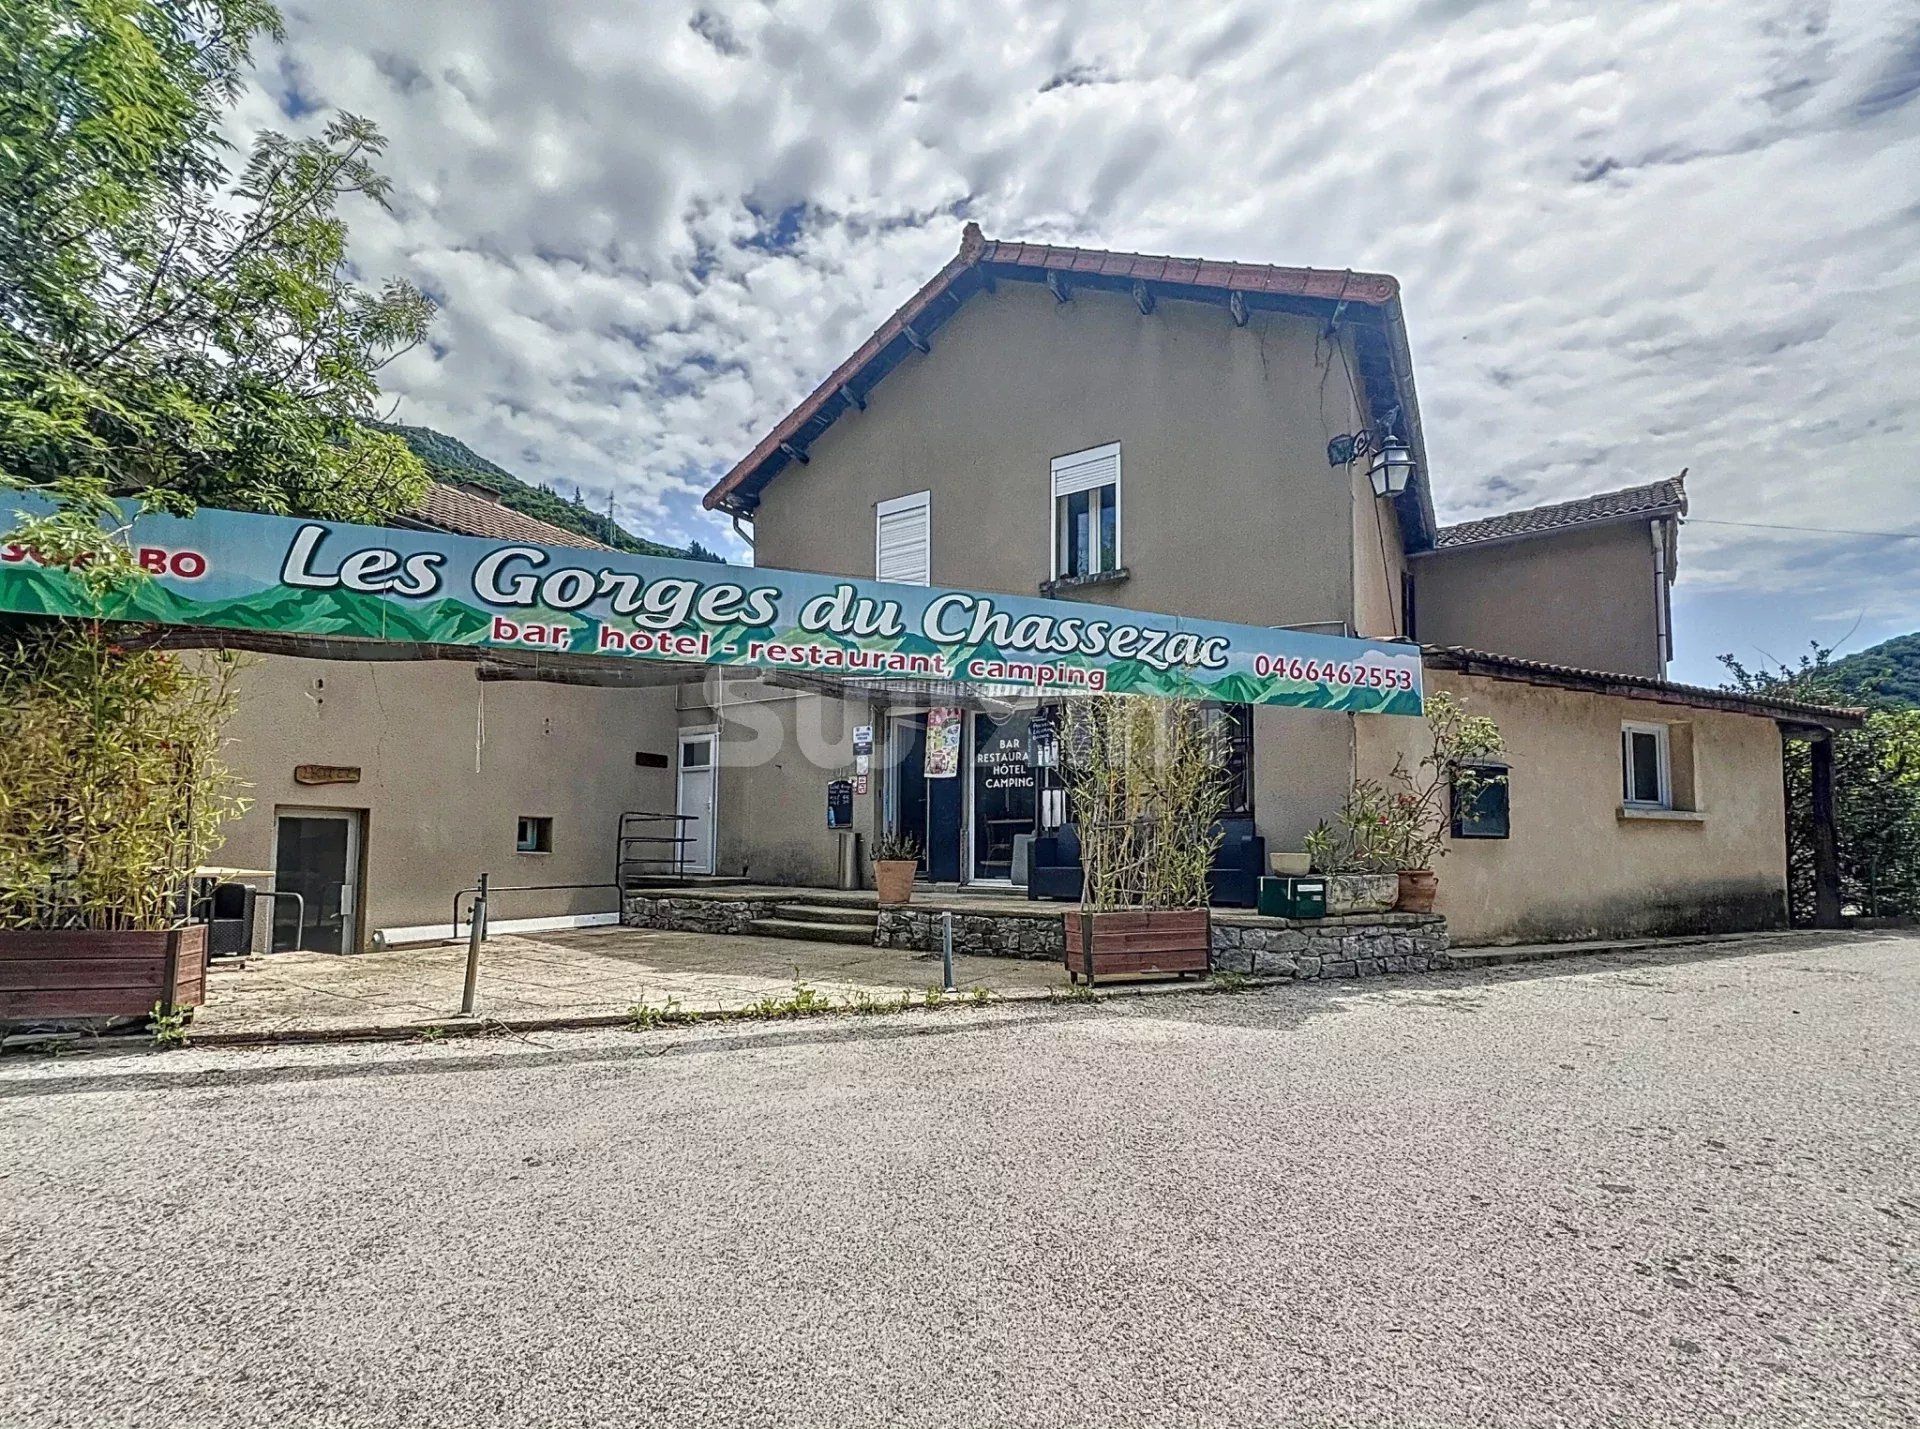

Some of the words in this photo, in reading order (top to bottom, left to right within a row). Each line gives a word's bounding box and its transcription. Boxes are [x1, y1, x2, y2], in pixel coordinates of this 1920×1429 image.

[281, 524, 446, 597] Les
[472, 545, 781, 630] Gorges
[800, 585, 904, 636] du
[921, 593, 1230, 669] Chassezac
[492, 616, 570, 649] bar,
[601, 627, 709, 655] hôtel
[750, 643, 952, 677] restaurant,
[969, 661, 1106, 691] camping
[1254, 655, 1413, 691] 0466462553
[999, 739, 1021, 749] BAR
[977, 752, 1030, 764] RESTAURA
[993, 762, 1027, 776] HÔTEL
[985, 777, 1035, 789] CAMPING
